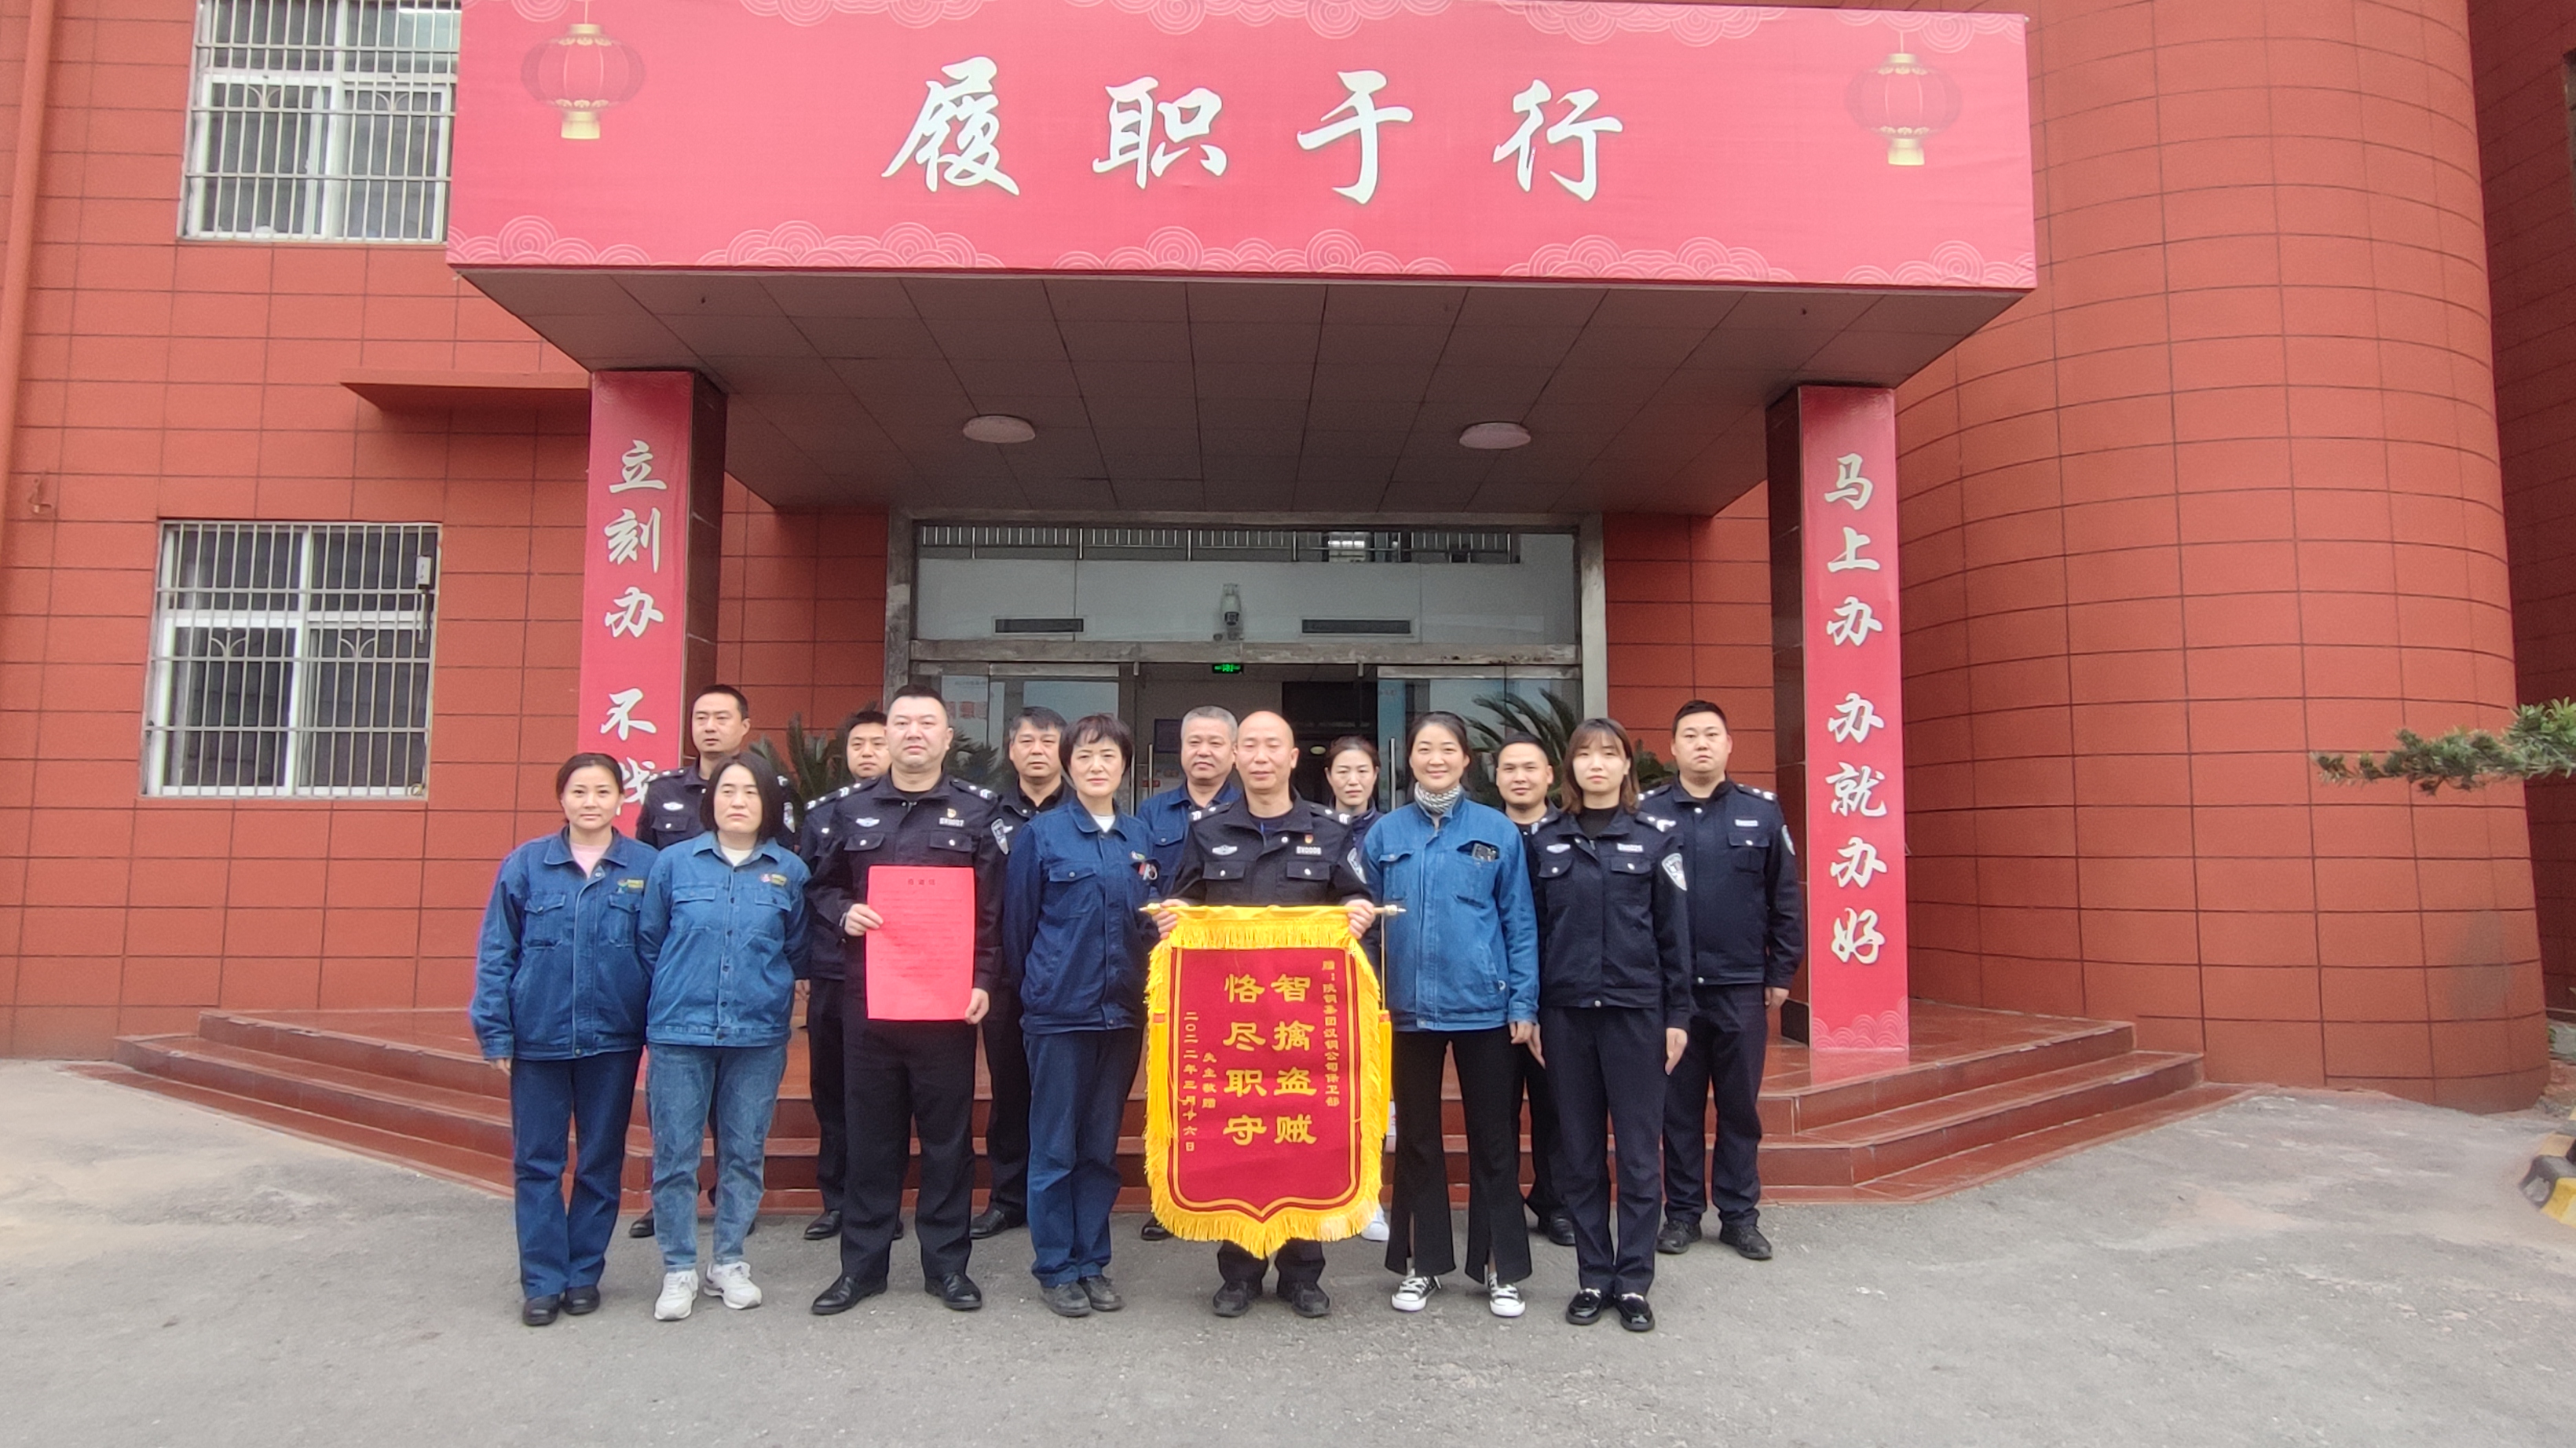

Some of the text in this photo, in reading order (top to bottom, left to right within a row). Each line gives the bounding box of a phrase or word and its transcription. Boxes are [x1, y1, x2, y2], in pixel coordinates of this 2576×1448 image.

[880, 56, 1623, 205] 履职于行
[604, 440, 668, 638] 立刻办
[1824, 452, 1887, 964] 马上办 办就办好
[1222, 973, 1268, 1146] 恪尽职守
[1270, 973, 1318, 1145] 智擒盗贼
